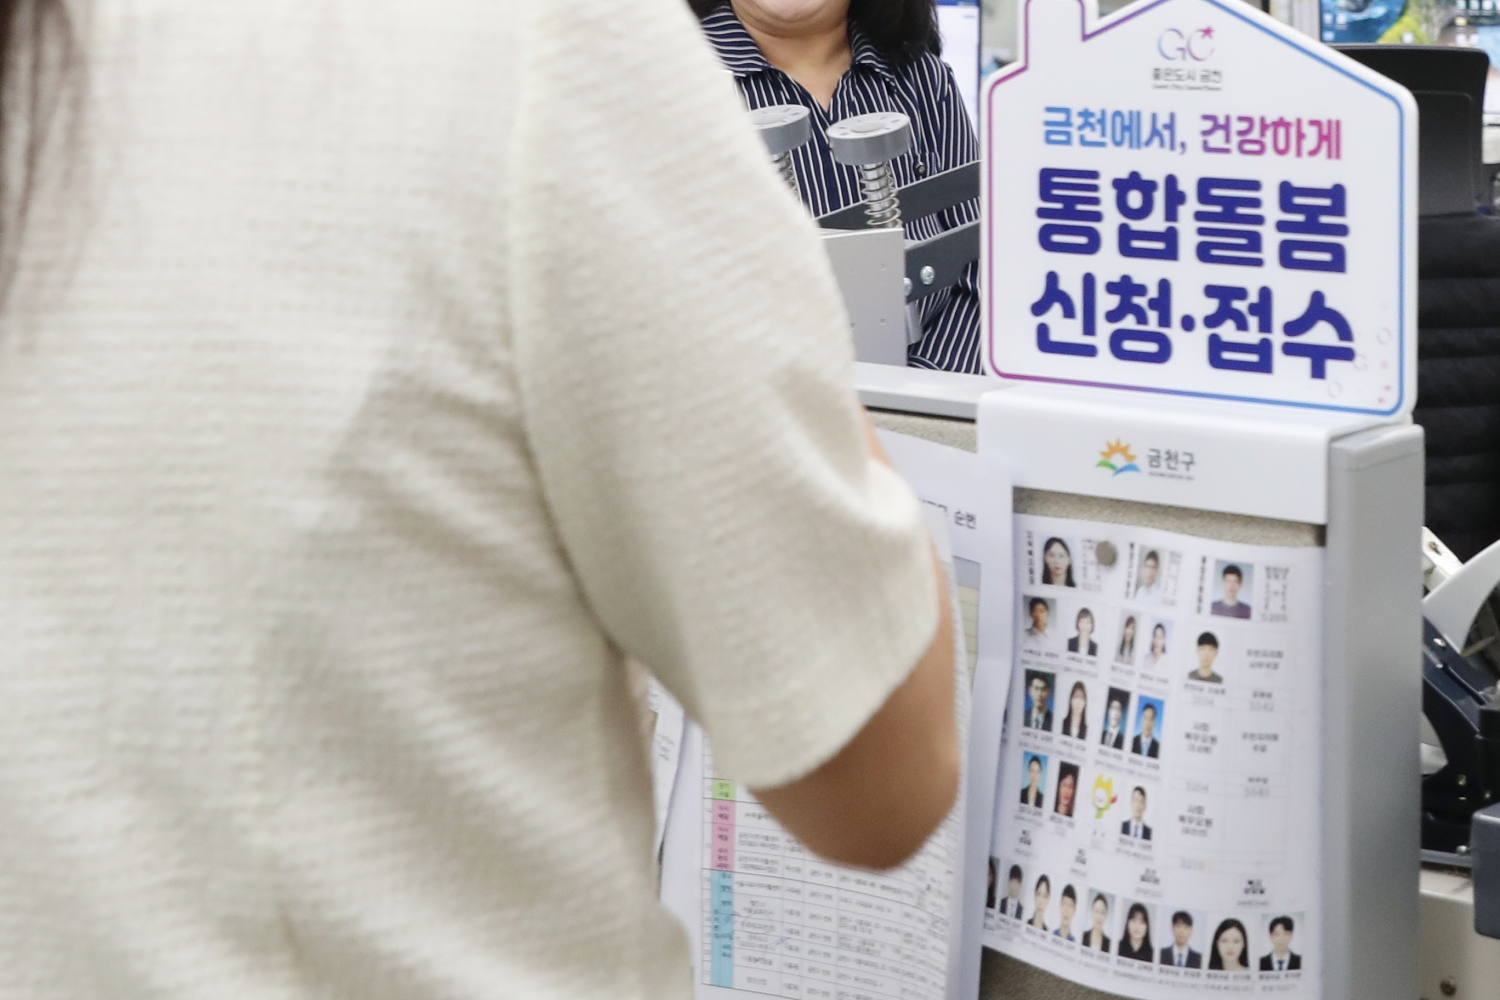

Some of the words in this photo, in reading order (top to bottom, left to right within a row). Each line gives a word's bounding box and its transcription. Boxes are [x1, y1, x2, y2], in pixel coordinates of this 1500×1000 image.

[1043, 106, 1187, 155] 금천에서,
[1200, 114, 1341, 160] 건강하게
[1036, 167, 1349, 273] 통합돌봄
[1030, 270, 1355, 380] 신청·접수
[1147, 448, 1195, 472] 금천구
